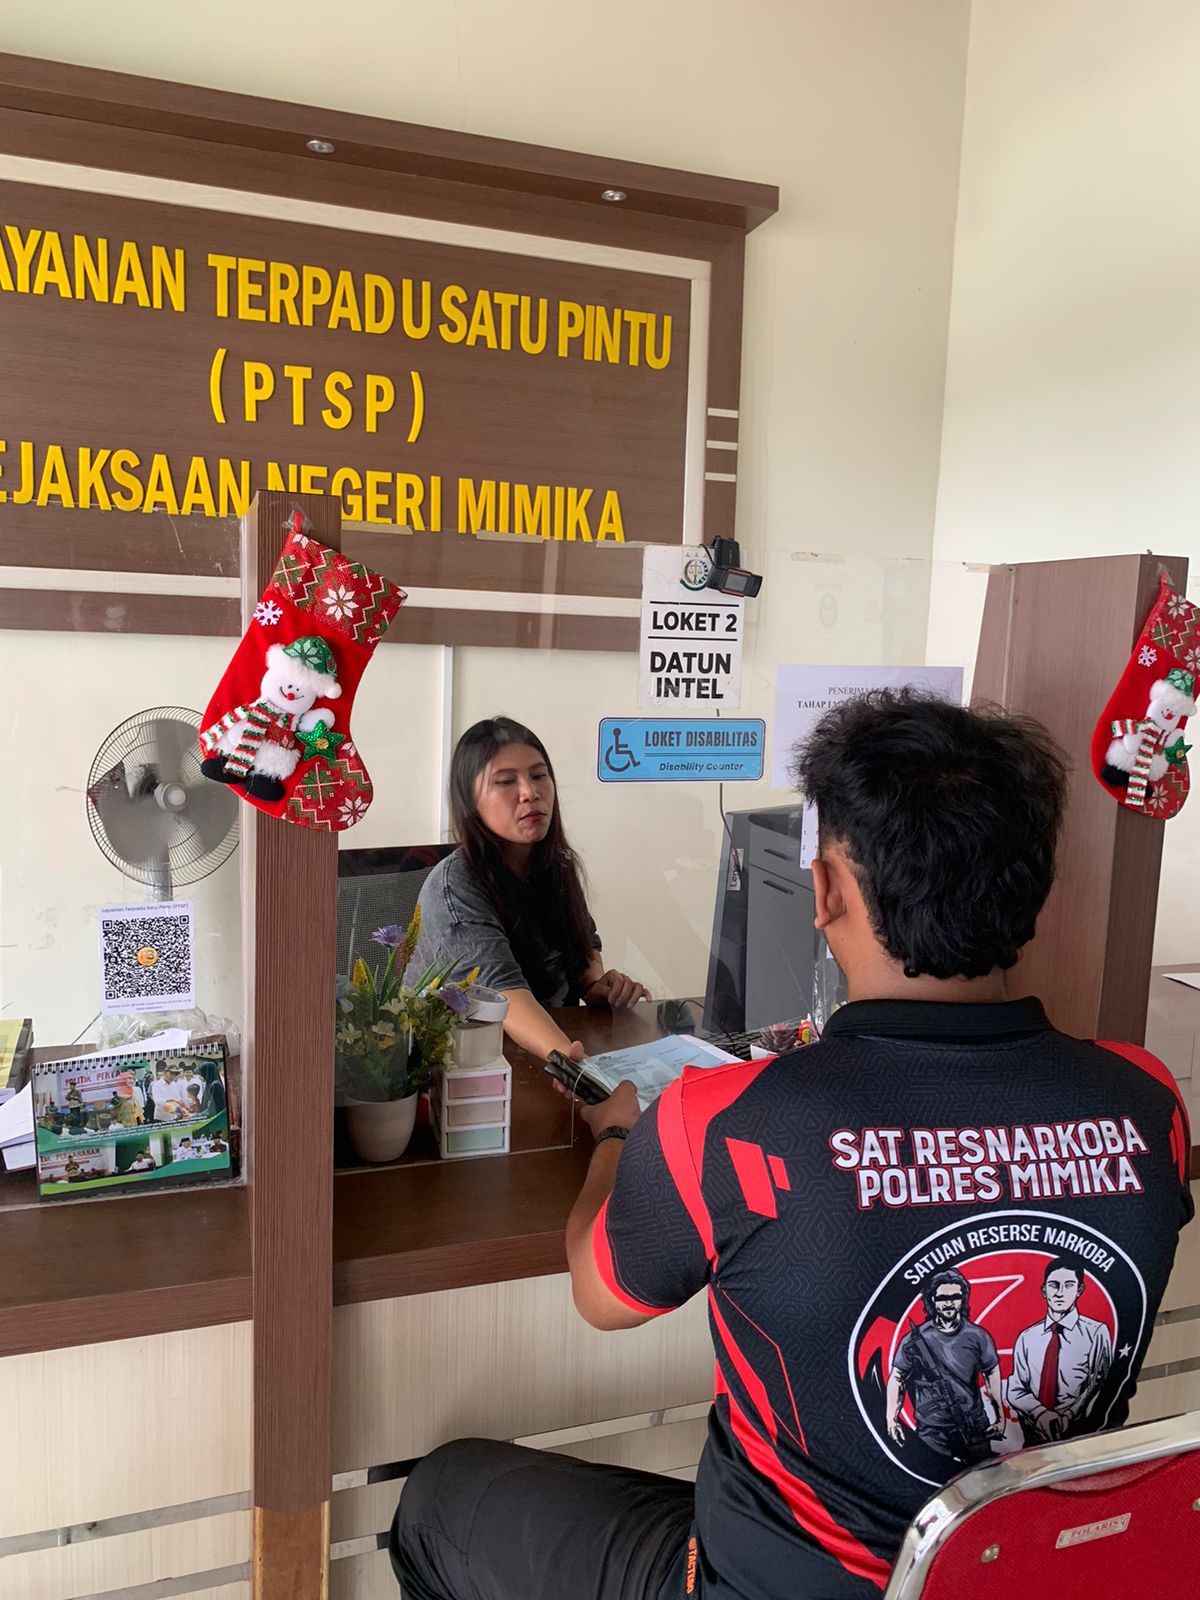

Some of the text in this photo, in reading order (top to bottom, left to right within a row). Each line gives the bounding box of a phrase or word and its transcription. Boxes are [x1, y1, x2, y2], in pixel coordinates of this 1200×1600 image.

[207, 253, 432, 340] TERPADU
[438, 285, 548, 355] SATU
[557, 300, 672, 370] PINTU
[0, 440, 250, 519] JAKSAAN
[457, 477, 626, 543] MIMIKA
[652, 611, 738, 632] LOKET 2
[650, 651, 731, 674] DATUN
[656, 677, 724, 699] INTEL
[797, 700, 827, 709] TAHAP
[644, 731, 758, 747] LOKET DISABILITAS
[659, 762, 744, 773] Disability Counter
[830, 1118, 1148, 1168] SAT RESNARKOBA
[857, 1156, 1142, 1207] POLRES MIMIKA
[903, 1224, 1116, 1285] SATUAN RESERSE NARKOBA
